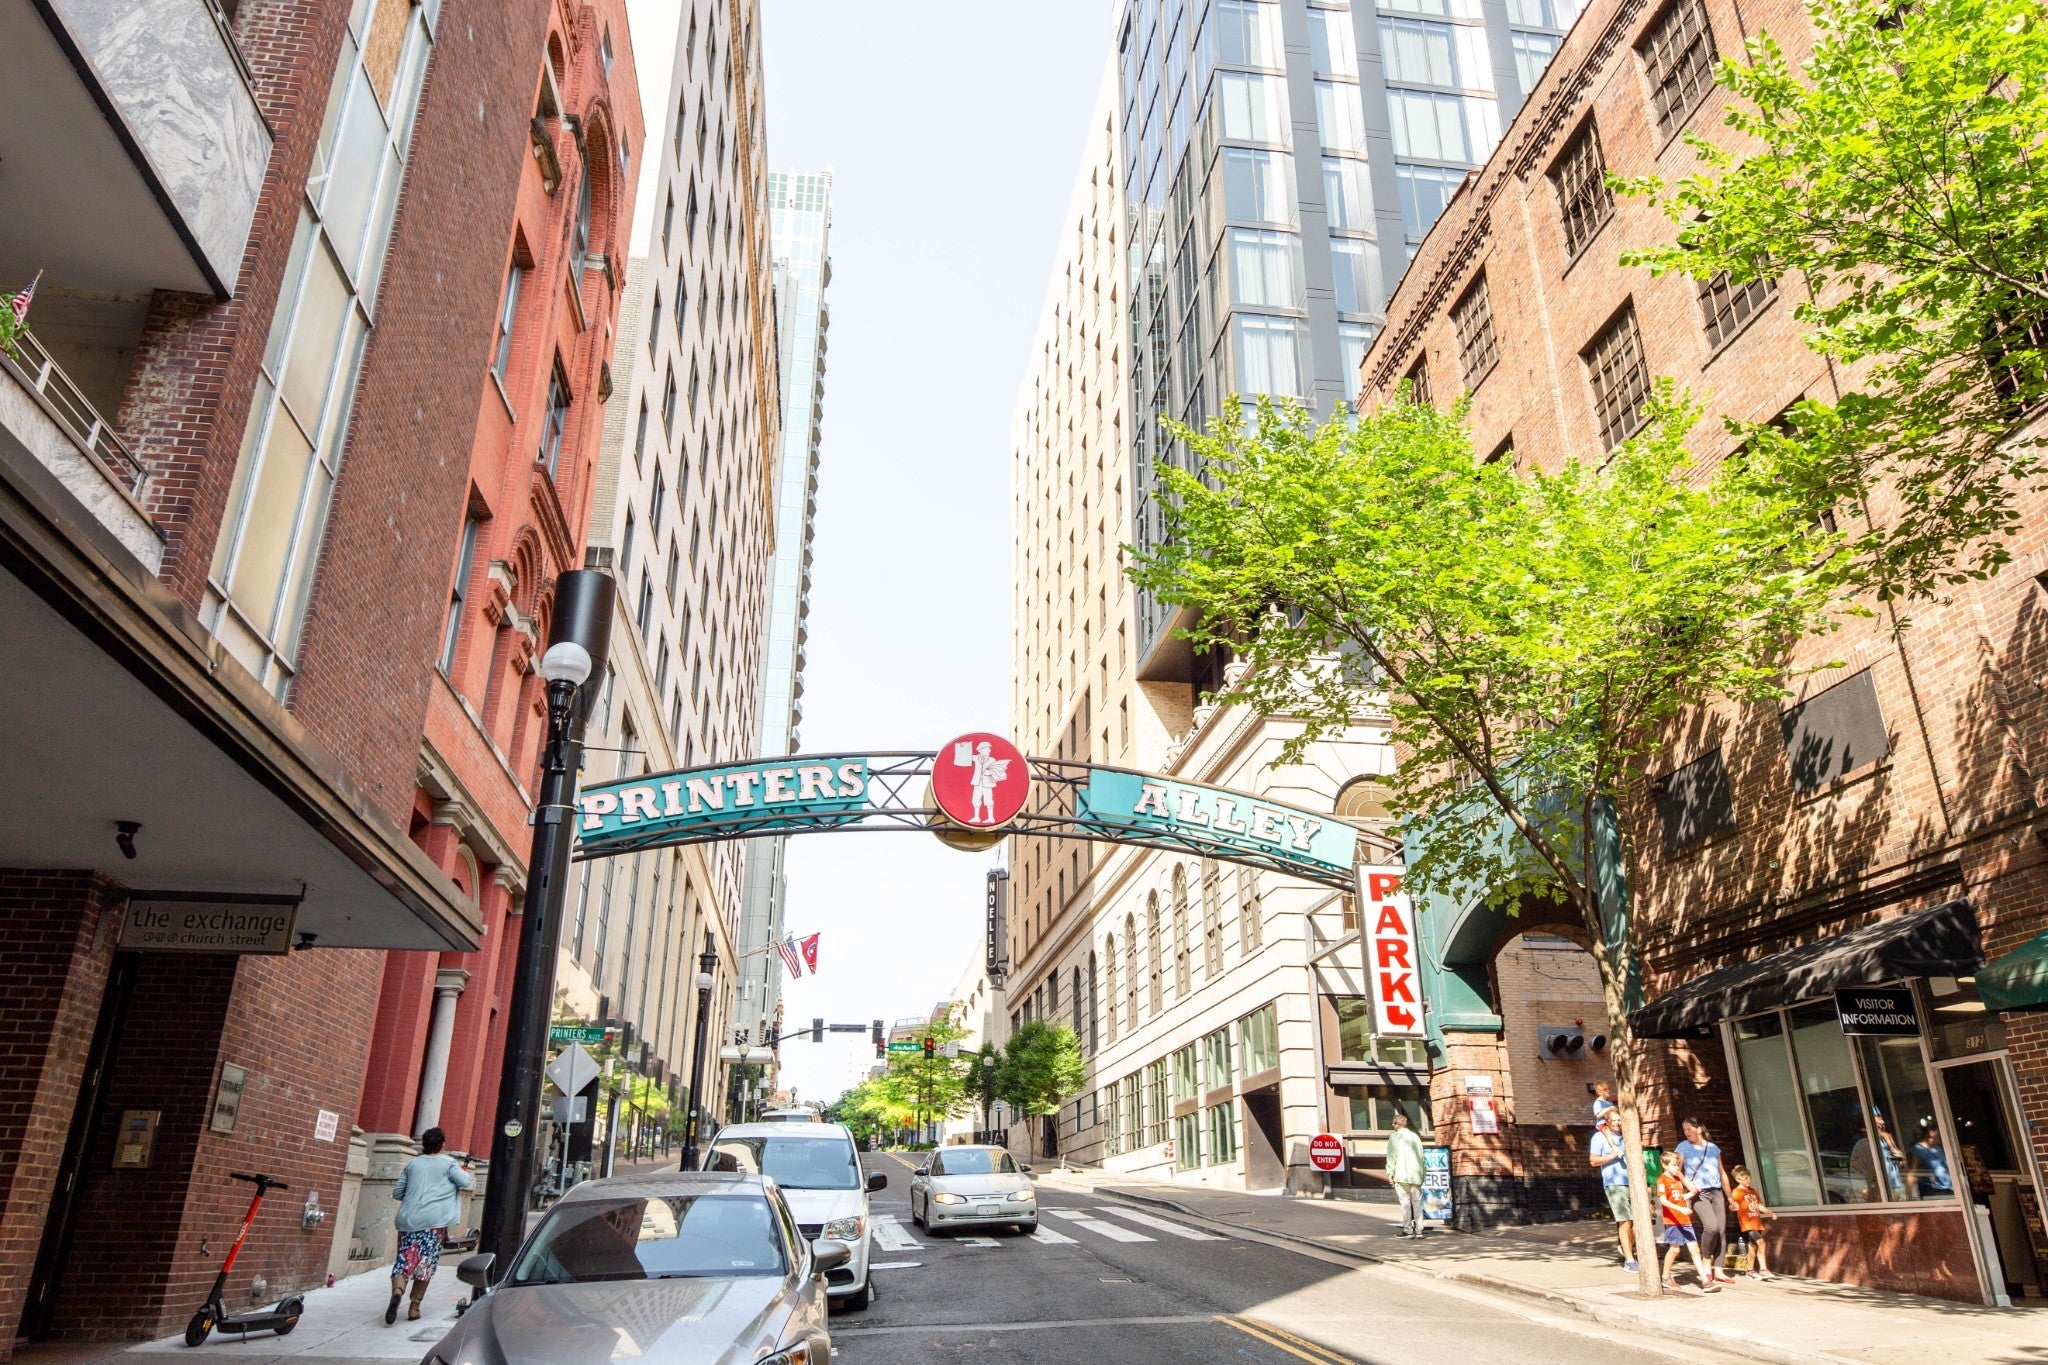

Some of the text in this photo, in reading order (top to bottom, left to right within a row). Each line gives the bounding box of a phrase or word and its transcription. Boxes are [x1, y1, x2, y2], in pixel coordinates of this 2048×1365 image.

[580, 762, 865, 831] PRINTERS
[1133, 782, 1322, 851] ALLEY
[133, 906, 285, 936] the exchange
[988, 881, 996, 959] NOELLE
[180, 932, 225, 944] church
[228, 935, 266, 946] street
[1368, 872, 1416, 1003] PARK
[1855, 998, 1895, 1010] VISITOR
[1842, 1013, 1916, 1025] INFORMATION
[550, 1028, 587, 1039] PRINTERS
[1966, 1036, 1984, 1048] 312
[1317, 1156, 1337, 1164] ENTER
[1424, 1155, 1446, 1168] ARK
[1424, 1174, 1448, 1187] ERE
